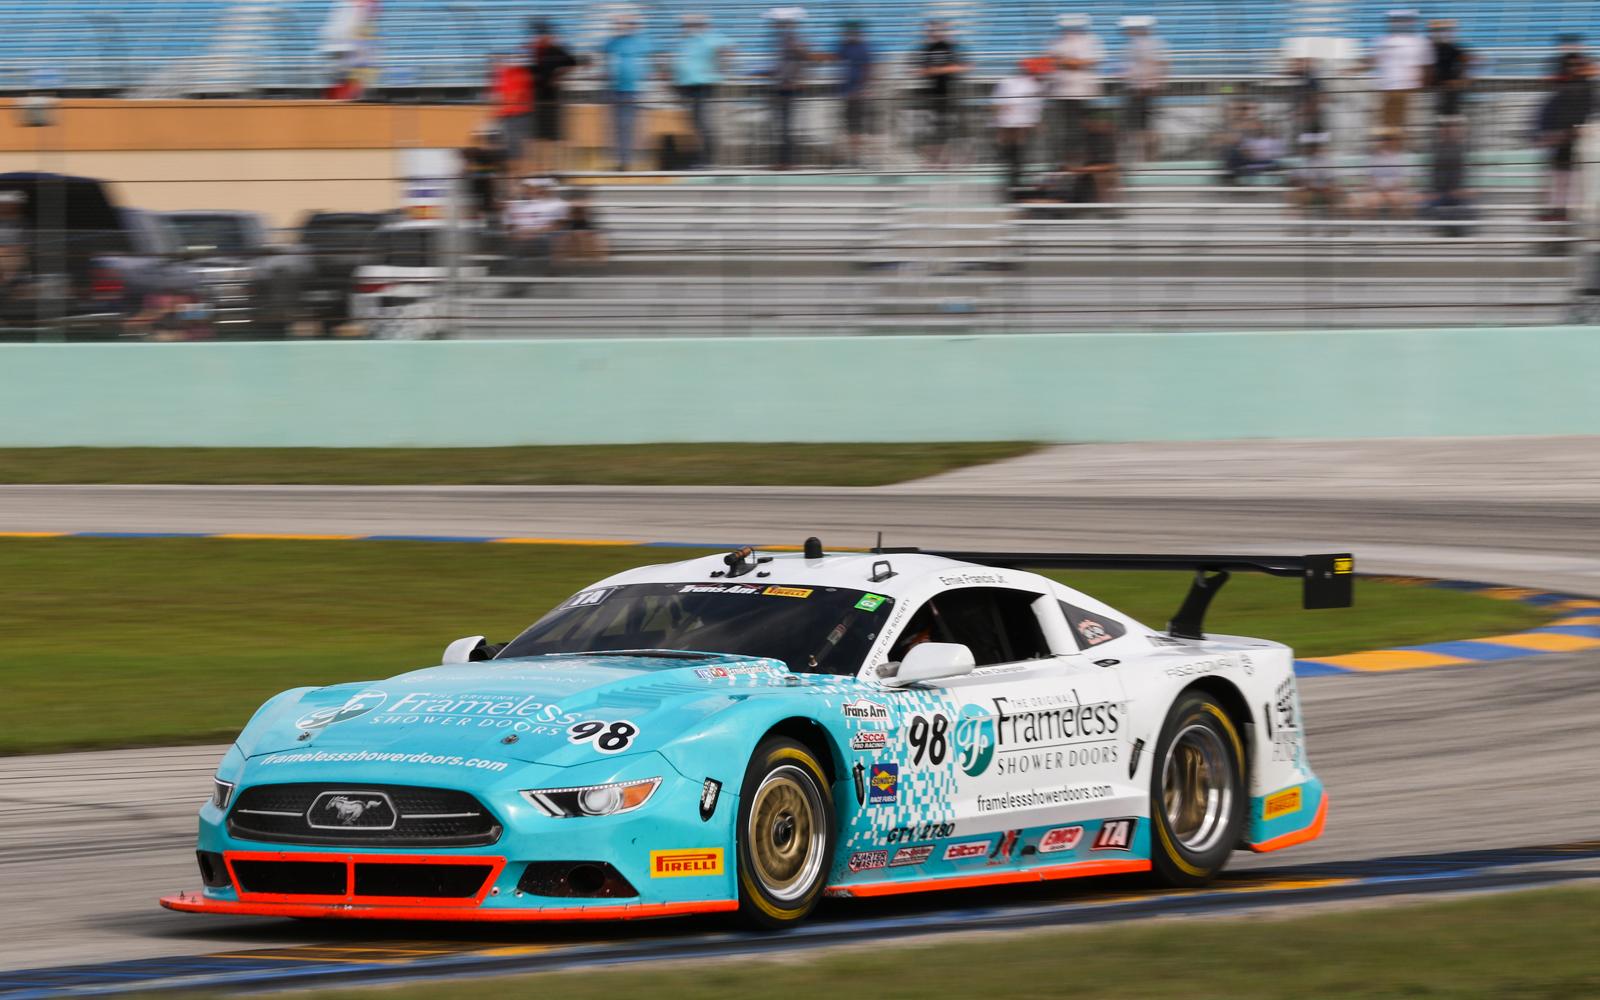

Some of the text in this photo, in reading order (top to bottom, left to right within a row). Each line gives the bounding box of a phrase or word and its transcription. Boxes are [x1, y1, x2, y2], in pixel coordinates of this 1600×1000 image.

[881, 629, 894, 647] CAR
[386, 692, 583, 725] Frameless
[842, 704, 887, 718] Trans Am
[992, 689, 1119, 745] Frameless
[367, 713, 562, 737] SHOWER DOORS
[571, 721, 637, 751] 98
[863, 733, 886, 742] SCCA
[909, 713, 949, 766] 98
[260, 750, 508, 772] framelessshowerdoors.com
[997, 745, 1120, 776] SHOWER DOORS
[977, 785, 1114, 811] framelessshowerdoors.com
[887, 823, 956, 843] GT1 2780
[1098, 820, 1130, 847] TA
[656, 853, 717, 873] PIRELLI
